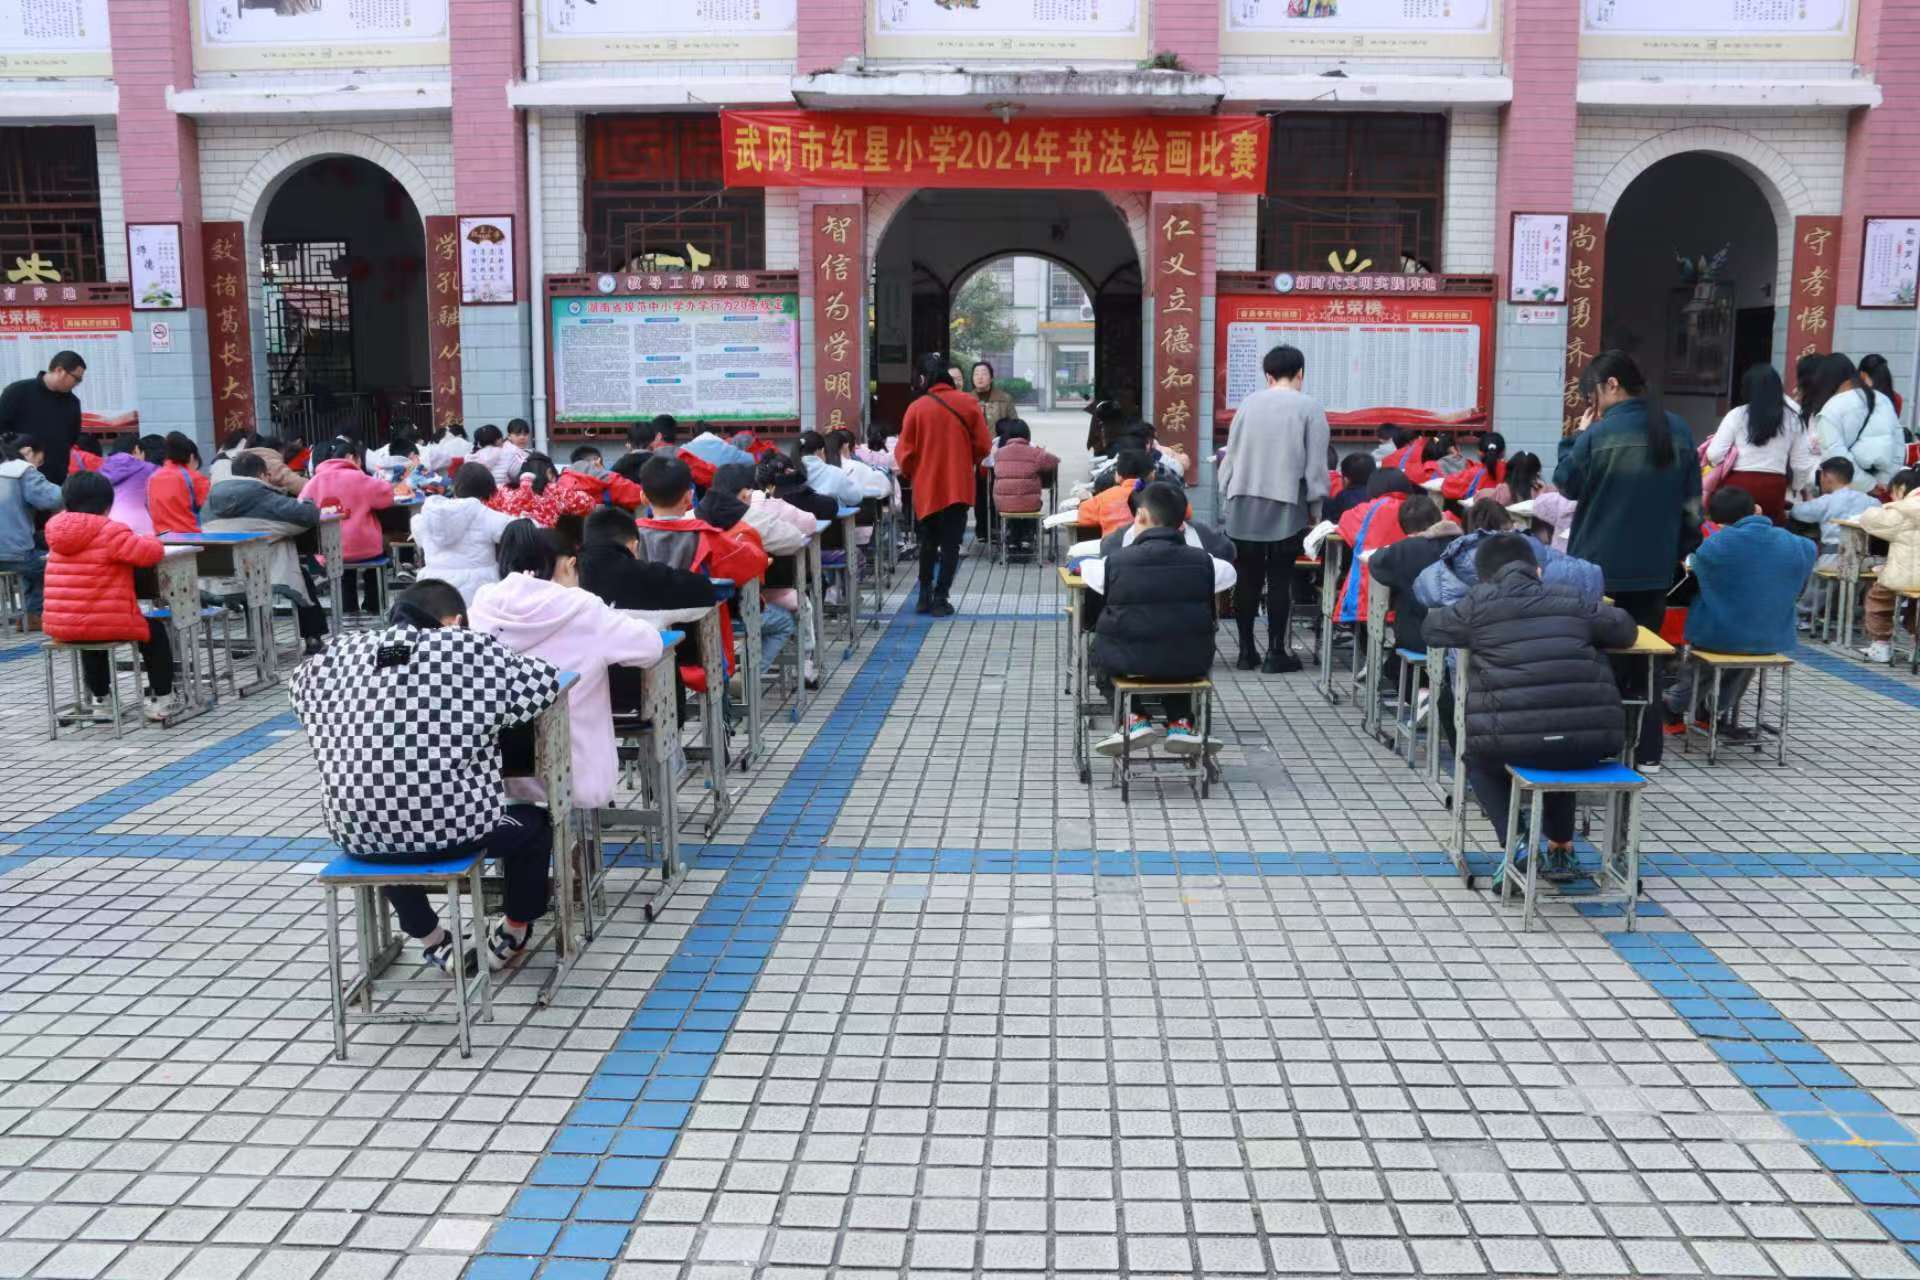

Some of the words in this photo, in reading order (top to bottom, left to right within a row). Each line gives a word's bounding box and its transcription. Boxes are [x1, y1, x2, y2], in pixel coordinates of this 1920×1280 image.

[735, 123, 1258, 180] 武冈市红星小学2024年书法绘画比赛
[1296, 275, 1437, 291] 新时代文明实践阵地
[1327, 299, 1383, 316] 光荣榜
